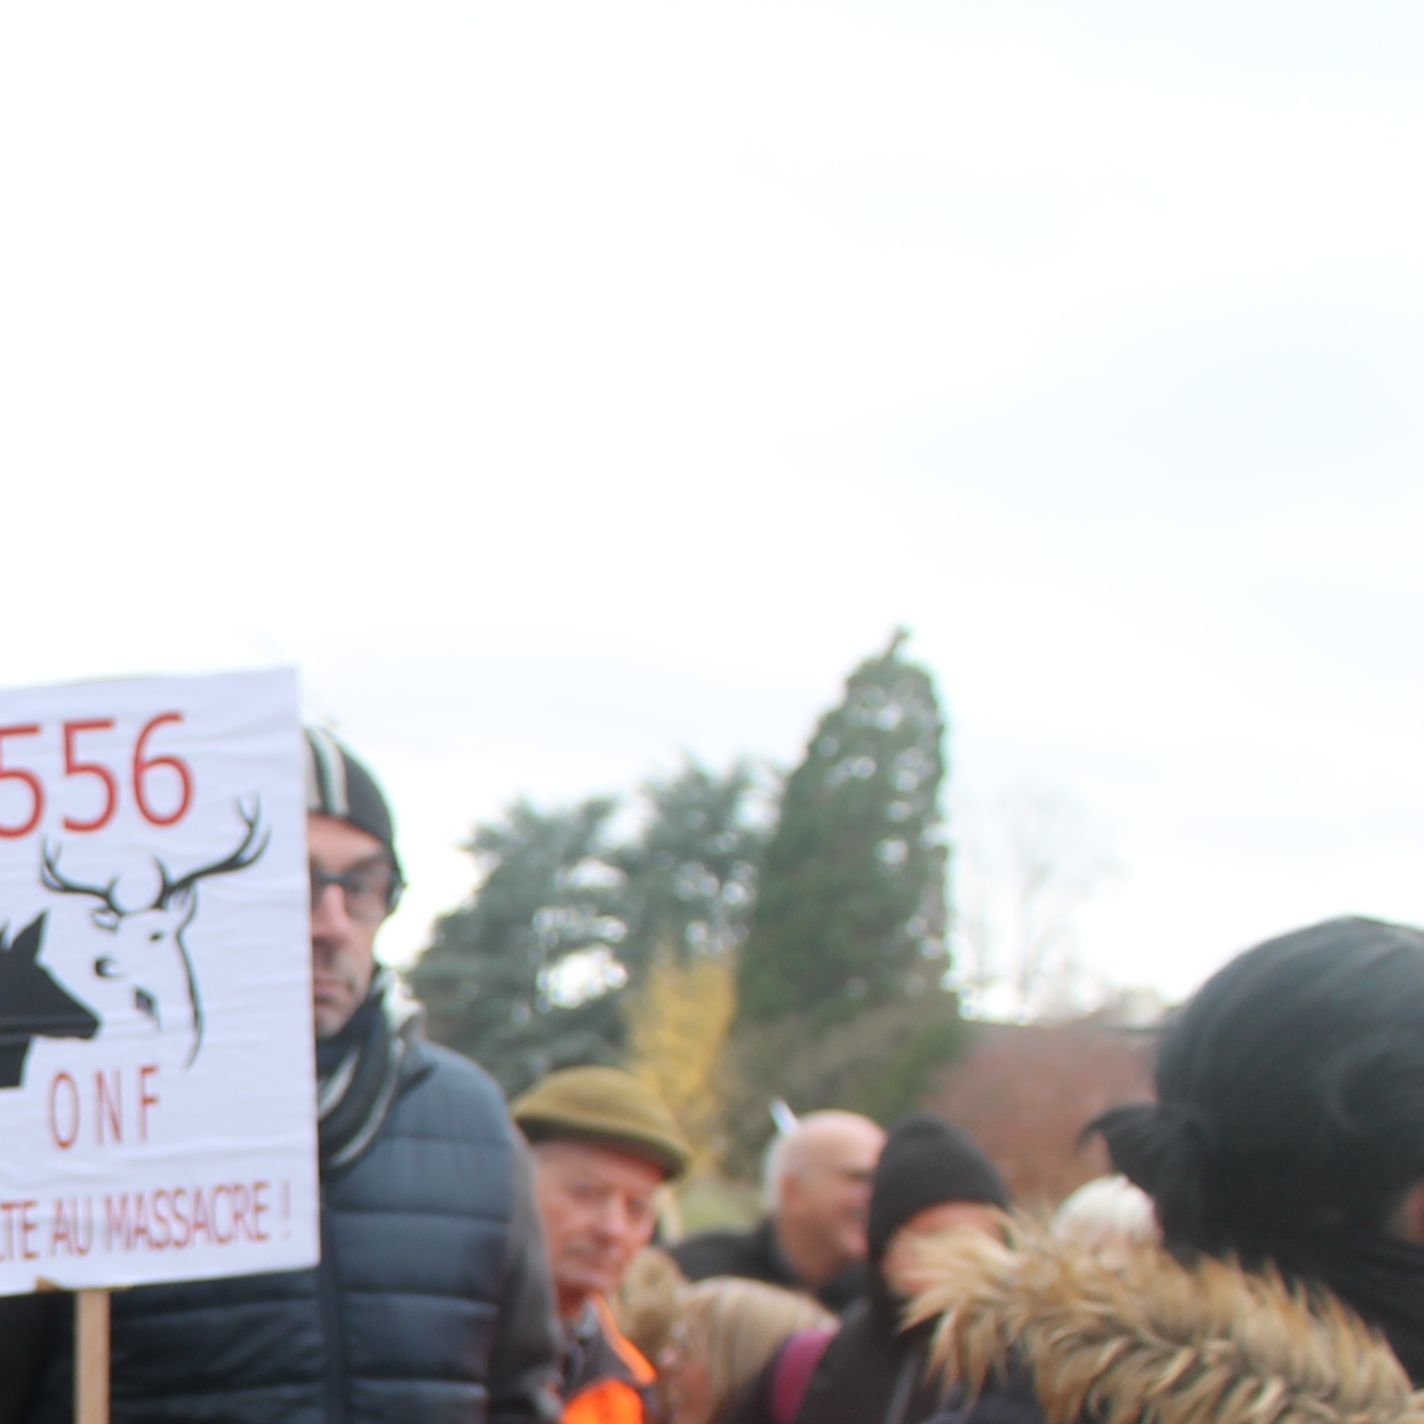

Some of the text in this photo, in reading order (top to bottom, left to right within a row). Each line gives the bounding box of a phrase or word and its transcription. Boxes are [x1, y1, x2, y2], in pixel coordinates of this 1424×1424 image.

[49, 1065, 159, 1149] ONF
[51, 1197, 94, 1257] AU
[103, 1181, 269, 1253] MASSACRE
